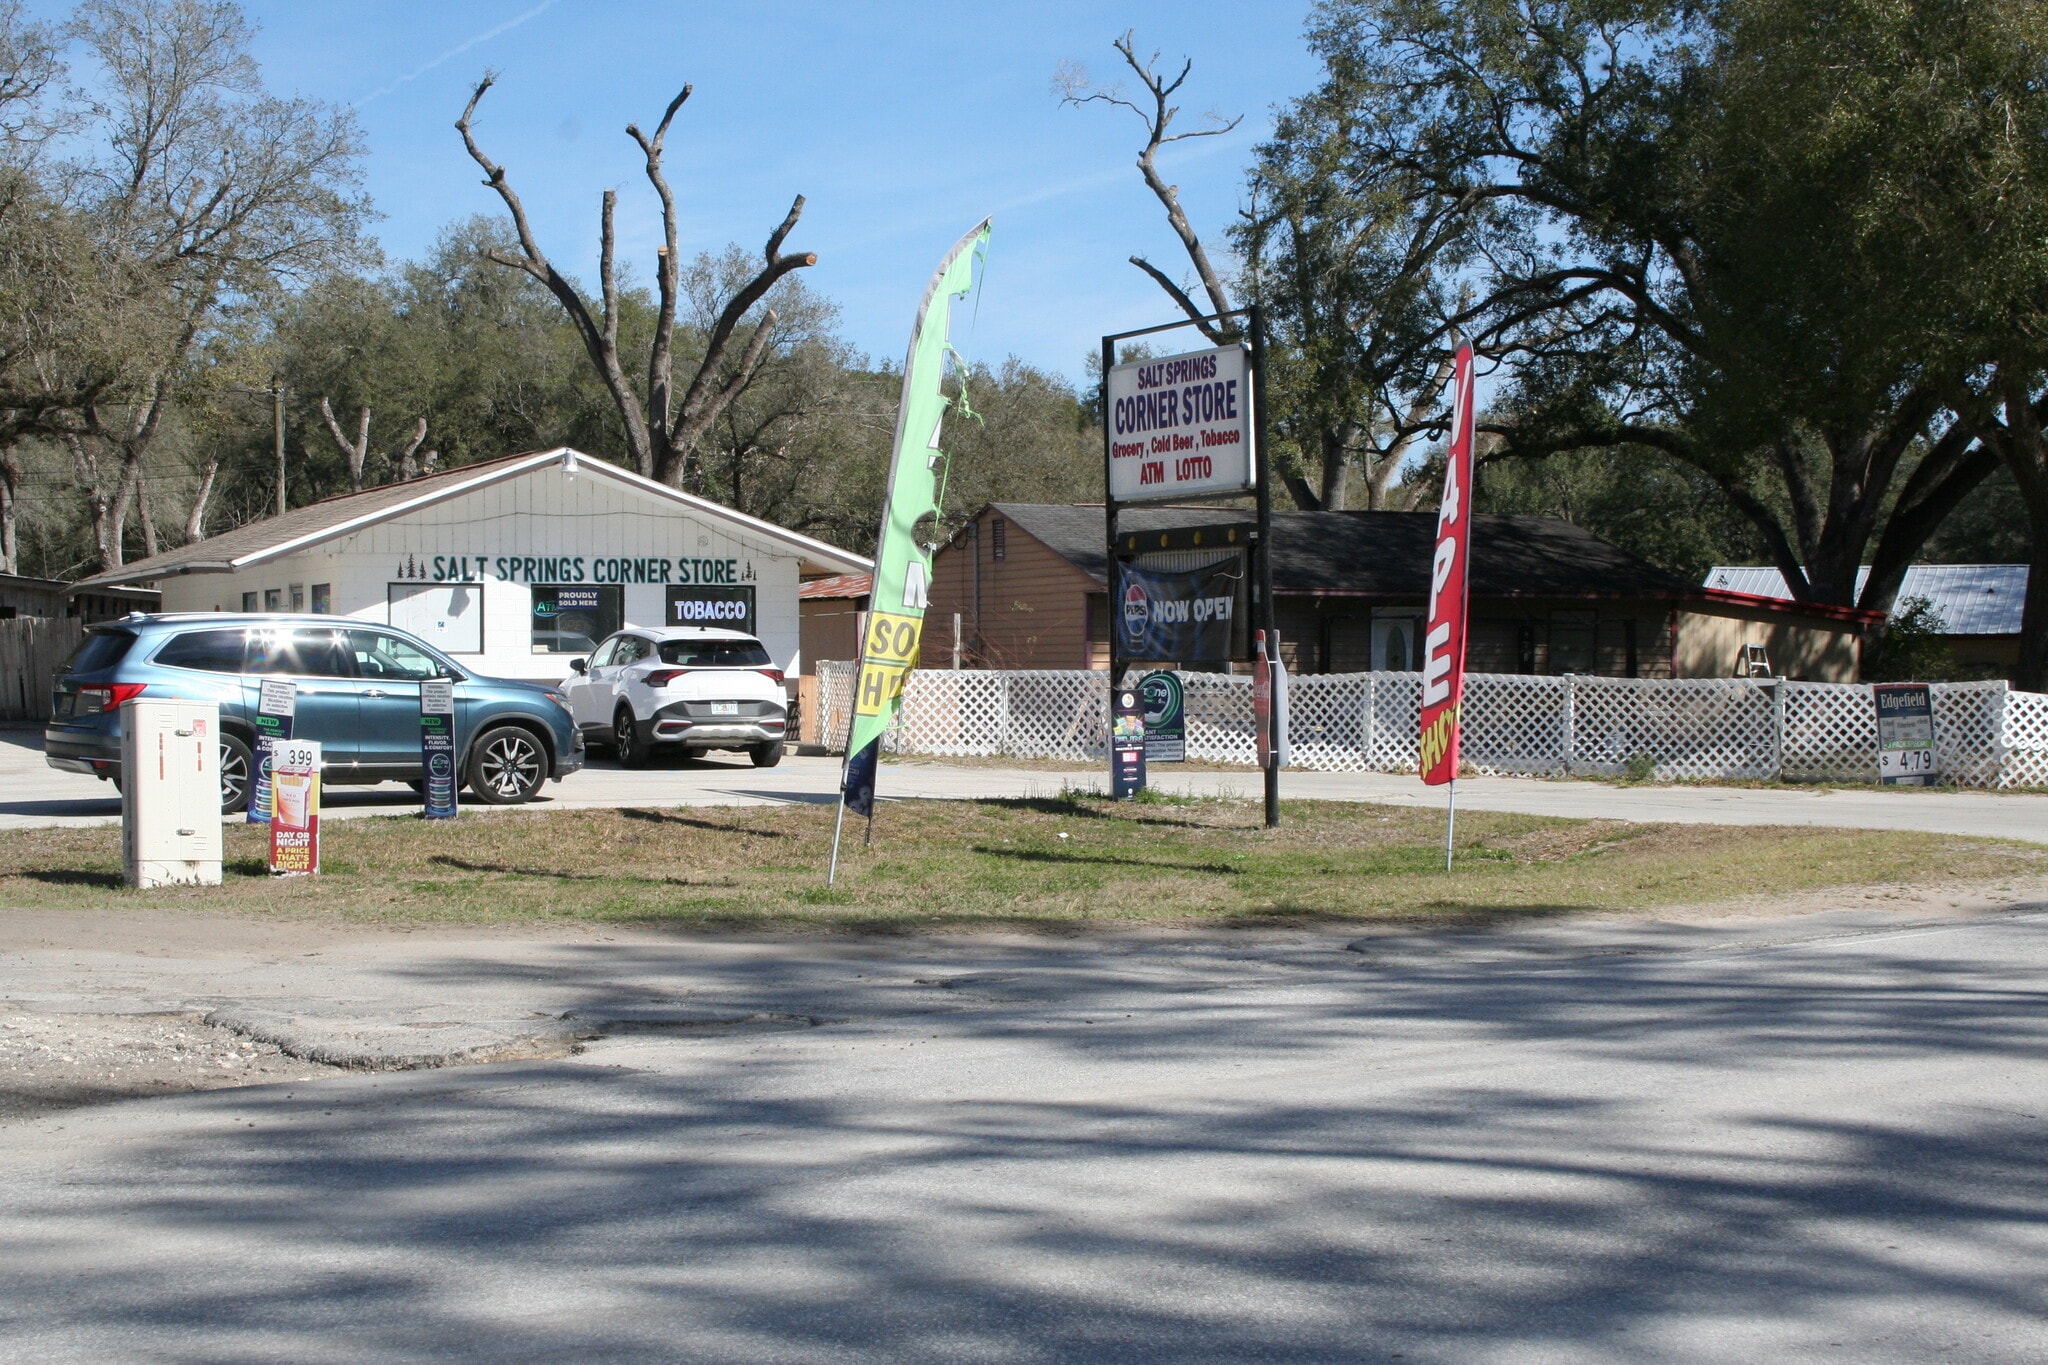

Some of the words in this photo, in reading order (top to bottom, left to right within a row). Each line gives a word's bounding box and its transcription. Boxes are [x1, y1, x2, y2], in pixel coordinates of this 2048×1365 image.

[1138, 364, 1165, 390] SALT
[1166, 355, 1217, 386] SPRINGS
[1115, 389, 1179, 436] CORNER
[1182, 379, 1238, 425] STORE
[1151, 434, 1171, 455] Cold
[1200, 428, 1240, 448] Tobacco
[1140, 460, 1165, 485] ATM
[1176, 455, 1212, 481] LOTTO
[1423, 358, 1472, 709] VAPE
[433, 556, 489, 582] SALT
[496, 556, 585, 583] SPRINGS
[594, 557, 672, 584] CORNER
[679, 558, 738, 584] STORE
[558, 591, 598, 599] PROUDLY
[674, 600, 747, 621] TOBACCO
[1126, 604, 1147, 616] PEPSI
[1153, 599, 1191, 623] NOW
[1193, 595, 1234, 622] OPEN
[1880, 691, 1926, 710] Edgefield
[261, 717, 278, 726] NEW
[289, 749, 312, 766] 3.99
[1899, 750, 1932, 772] 4.79
[276, 831, 296, 839] DAY
[276, 838, 310, 846] NIGHT
[276, 853, 310, 861] THAT'S
[276, 861, 310, 869] RIGHT
